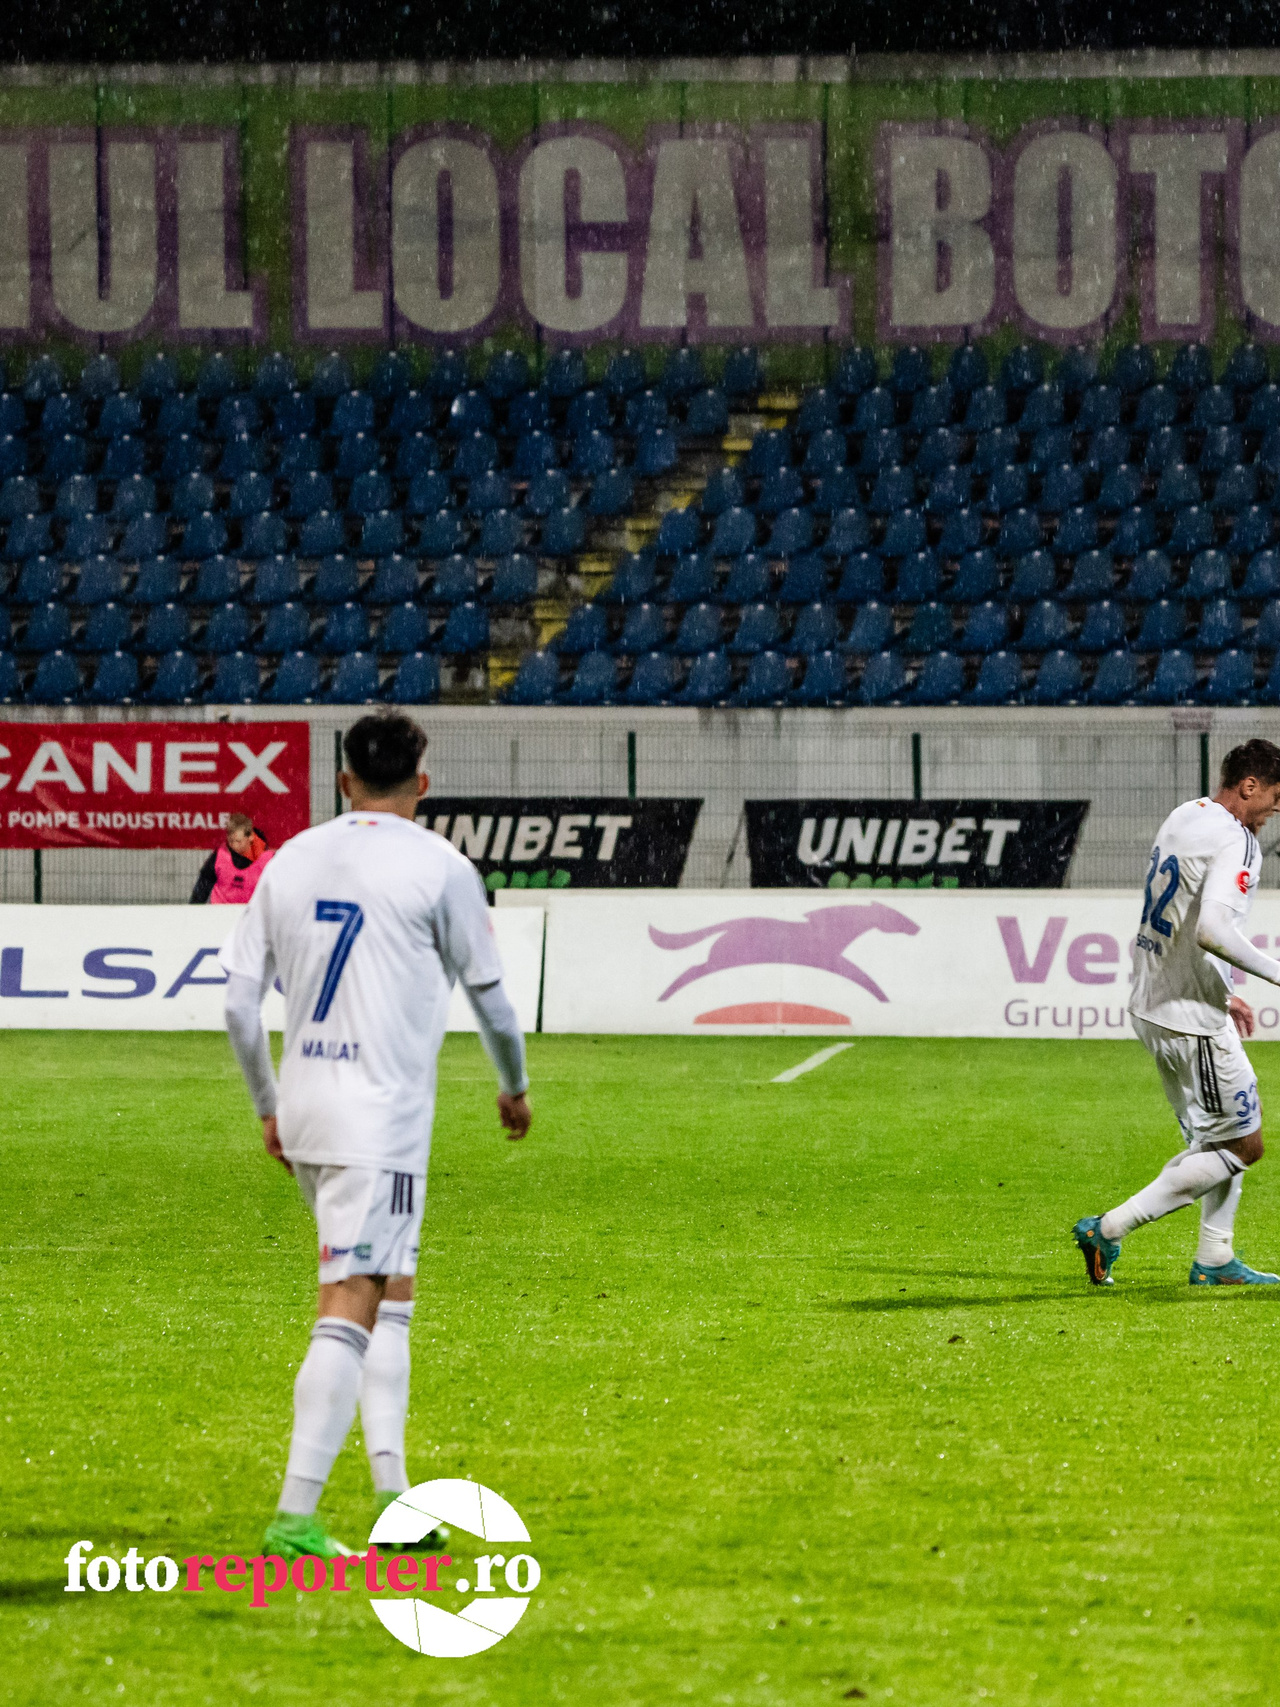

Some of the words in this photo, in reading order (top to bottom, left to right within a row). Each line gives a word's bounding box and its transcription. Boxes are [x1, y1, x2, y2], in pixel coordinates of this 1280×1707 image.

[306, 136, 840, 333] LOCAL
[0, 741, 290, 794] ANEX
[8, 811, 80, 829] POMPE
[86, 811, 230, 829] INDUSTRIALE
[797, 817, 1021, 866] UNIBET
[316, 900, 364, 1022] 7
[1005, 999, 1125, 1035] Grupu
